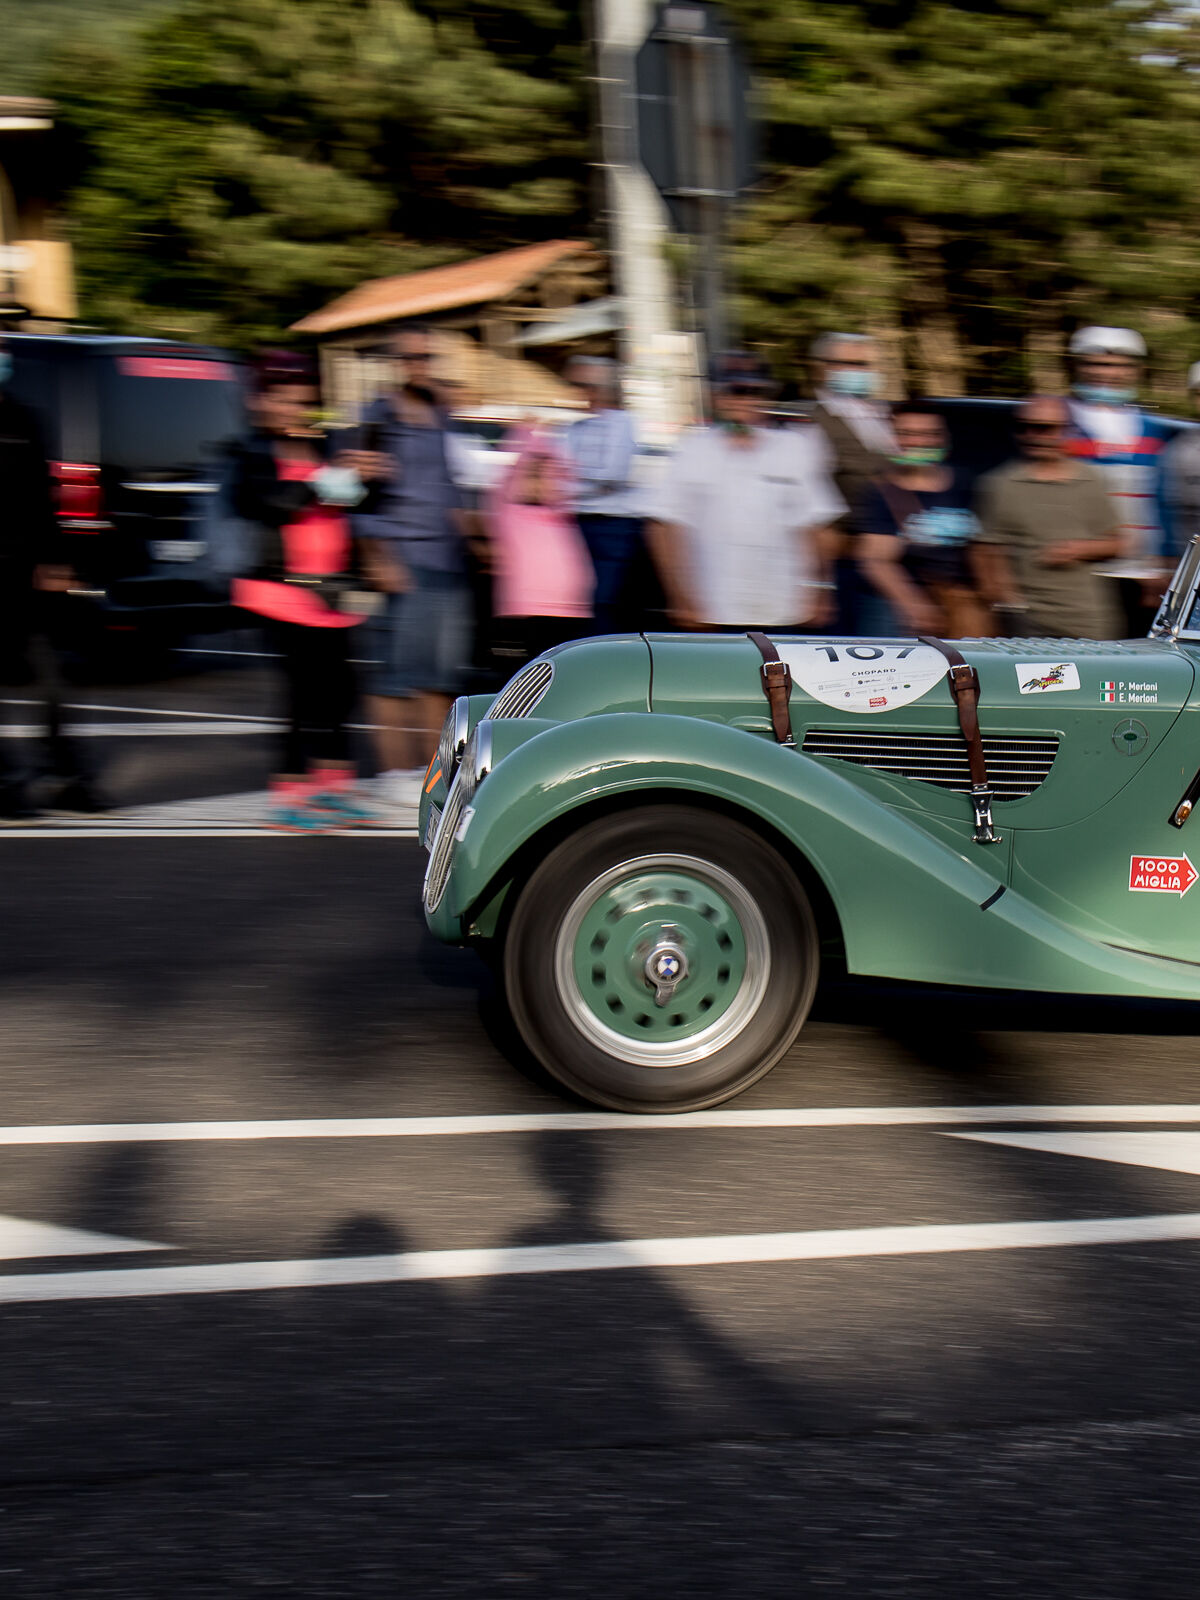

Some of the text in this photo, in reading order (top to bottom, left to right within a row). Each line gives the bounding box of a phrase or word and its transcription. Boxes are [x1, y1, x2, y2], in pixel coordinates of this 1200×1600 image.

[815, 646, 916, 662] 107
[852, 668, 896, 677] CHOPARD
[1119, 681, 1158, 691] P. Merloni
[1119, 692, 1158, 703] E. Merloni
[1138, 860, 1179, 873] 1000
[1134, 874, 1181, 888] MIGLIA
